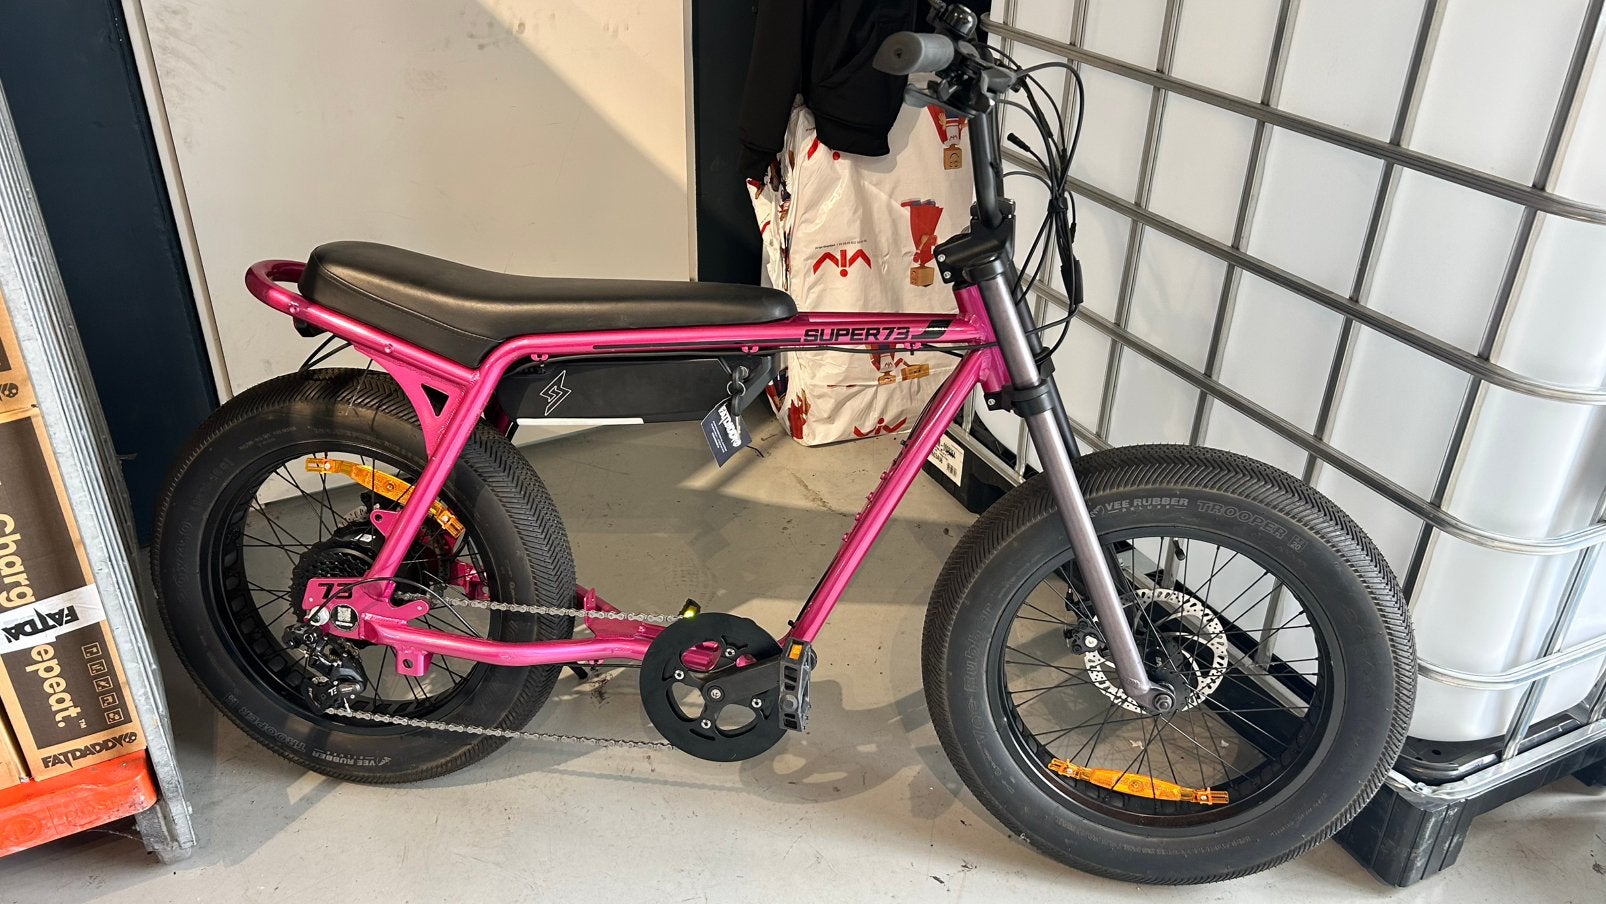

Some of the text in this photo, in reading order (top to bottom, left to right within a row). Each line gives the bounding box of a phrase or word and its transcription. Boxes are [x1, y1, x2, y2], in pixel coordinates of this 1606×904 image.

[803, 326, 911, 343] SUPER73
[1105, 499, 1130, 511] VEE
[1133, 497, 1189, 507] RUBBER
[1197, 500, 1288, 539] TROOPER
[317, 582, 354, 599] 73
[0, 513, 36, 608] Charg
[25, 644, 82, 729] epeat.
[0, 605, 80, 644] FATDA
[41, 735, 126, 768] FATDADDY
[311, 750, 355, 765] RUBBER
